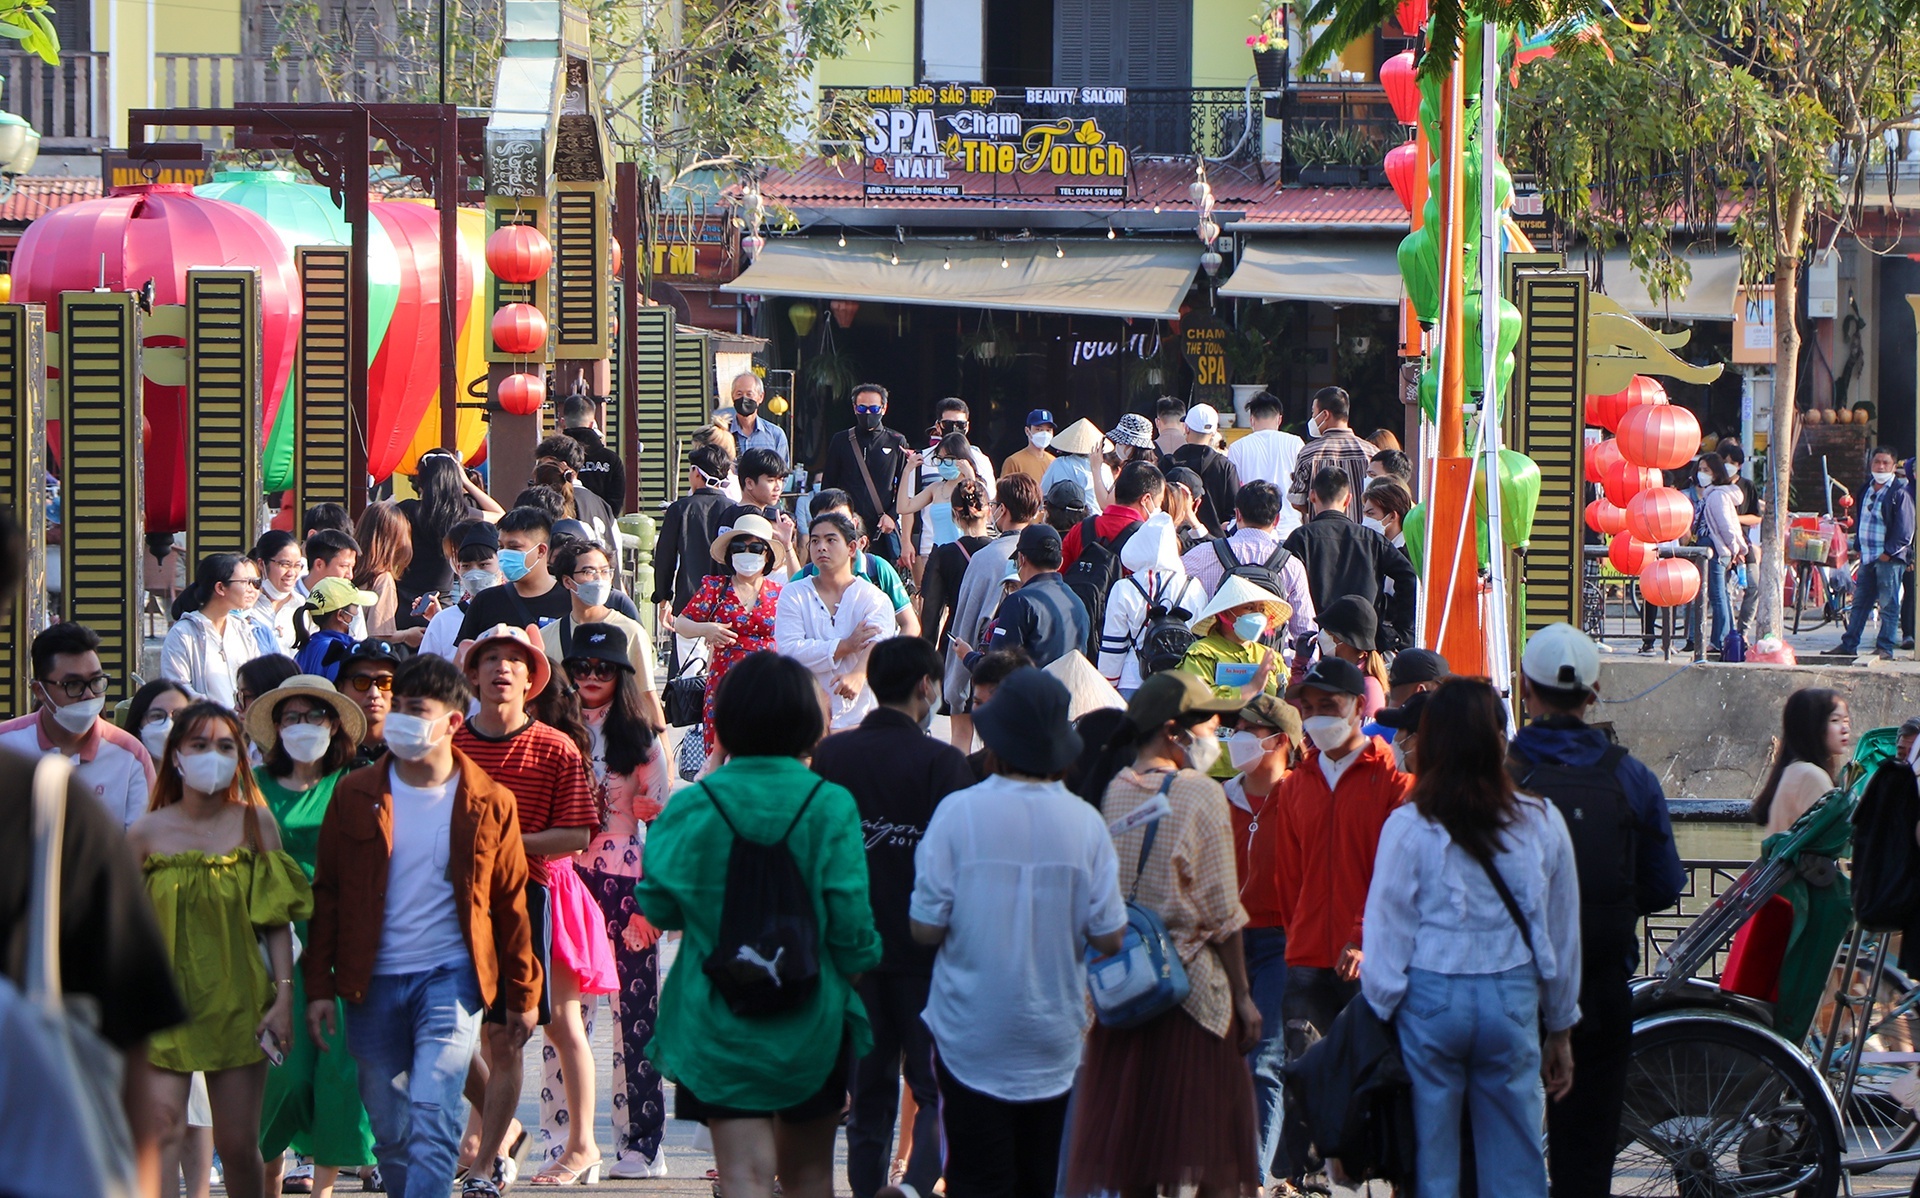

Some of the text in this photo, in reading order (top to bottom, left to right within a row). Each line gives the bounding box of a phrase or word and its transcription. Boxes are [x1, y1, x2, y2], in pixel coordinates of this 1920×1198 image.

[868, 83, 994, 107] CHĂM SÓC SẮC ĐẸP
[1026, 89, 1125, 104] BEAUTY SALON
[865, 110, 938, 155] SPA
[955, 112, 1019, 140] Chạm
[963, 119, 1124, 175] The Touch
[157, 168, 204, 184] MART
[873, 158, 947, 178] & NAIL
[866, 186, 883, 194] ADD:
[1186, 342, 1202, 355] THE
[1198, 356, 1226, 385] SPA
[861, 816, 925, 849] aigon
[889, 836, 919, 846] 201
